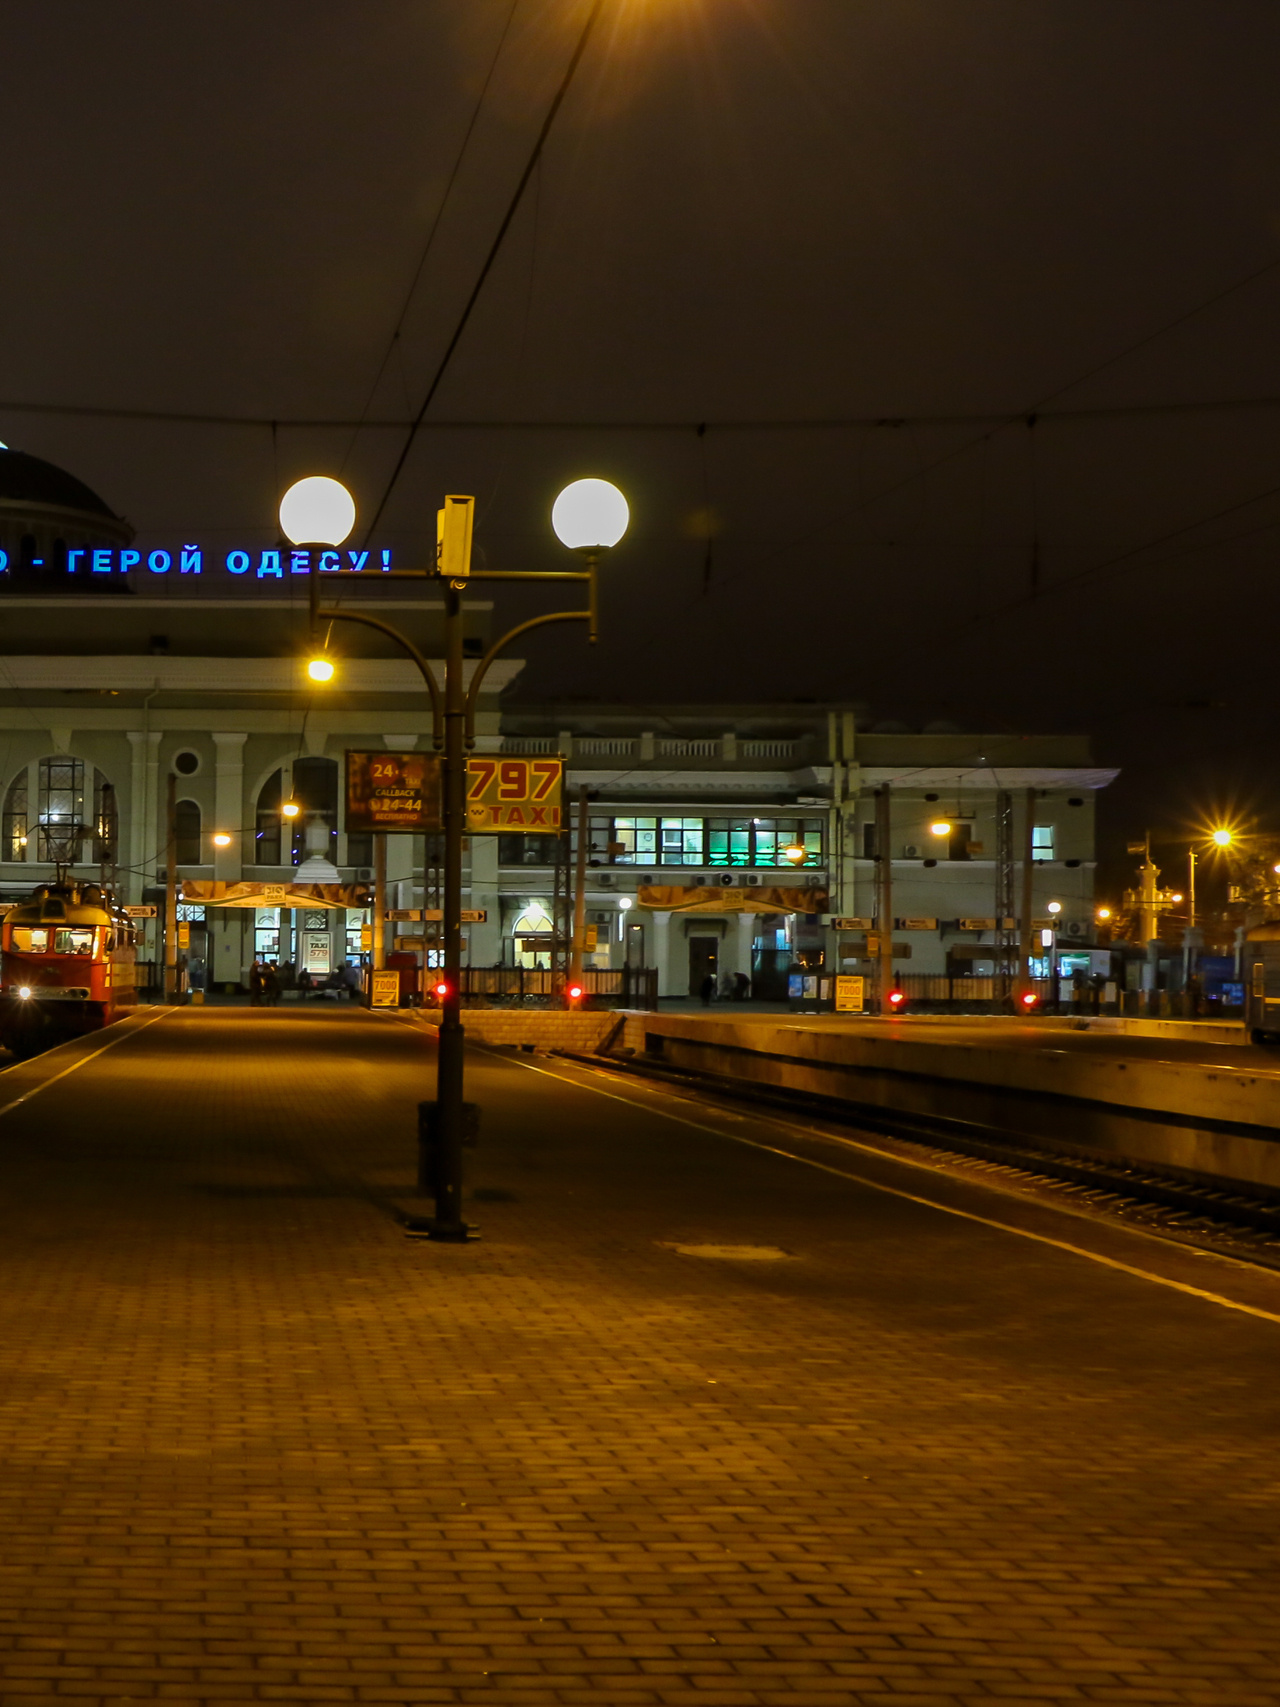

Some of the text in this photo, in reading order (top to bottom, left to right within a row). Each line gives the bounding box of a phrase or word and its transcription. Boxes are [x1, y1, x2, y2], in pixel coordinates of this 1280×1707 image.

[67, 544, 203, 574] ГЕРОЙ
[225, 549, 392, 579] ОДЕСУ!
[467, 761, 561, 801] 797
[375, 789, 416, 797] CALLBACK
[488, 805, 561, 825] TAXI
[375, 980, 397, 991] 7000
[838, 985, 861, 996] 7000
